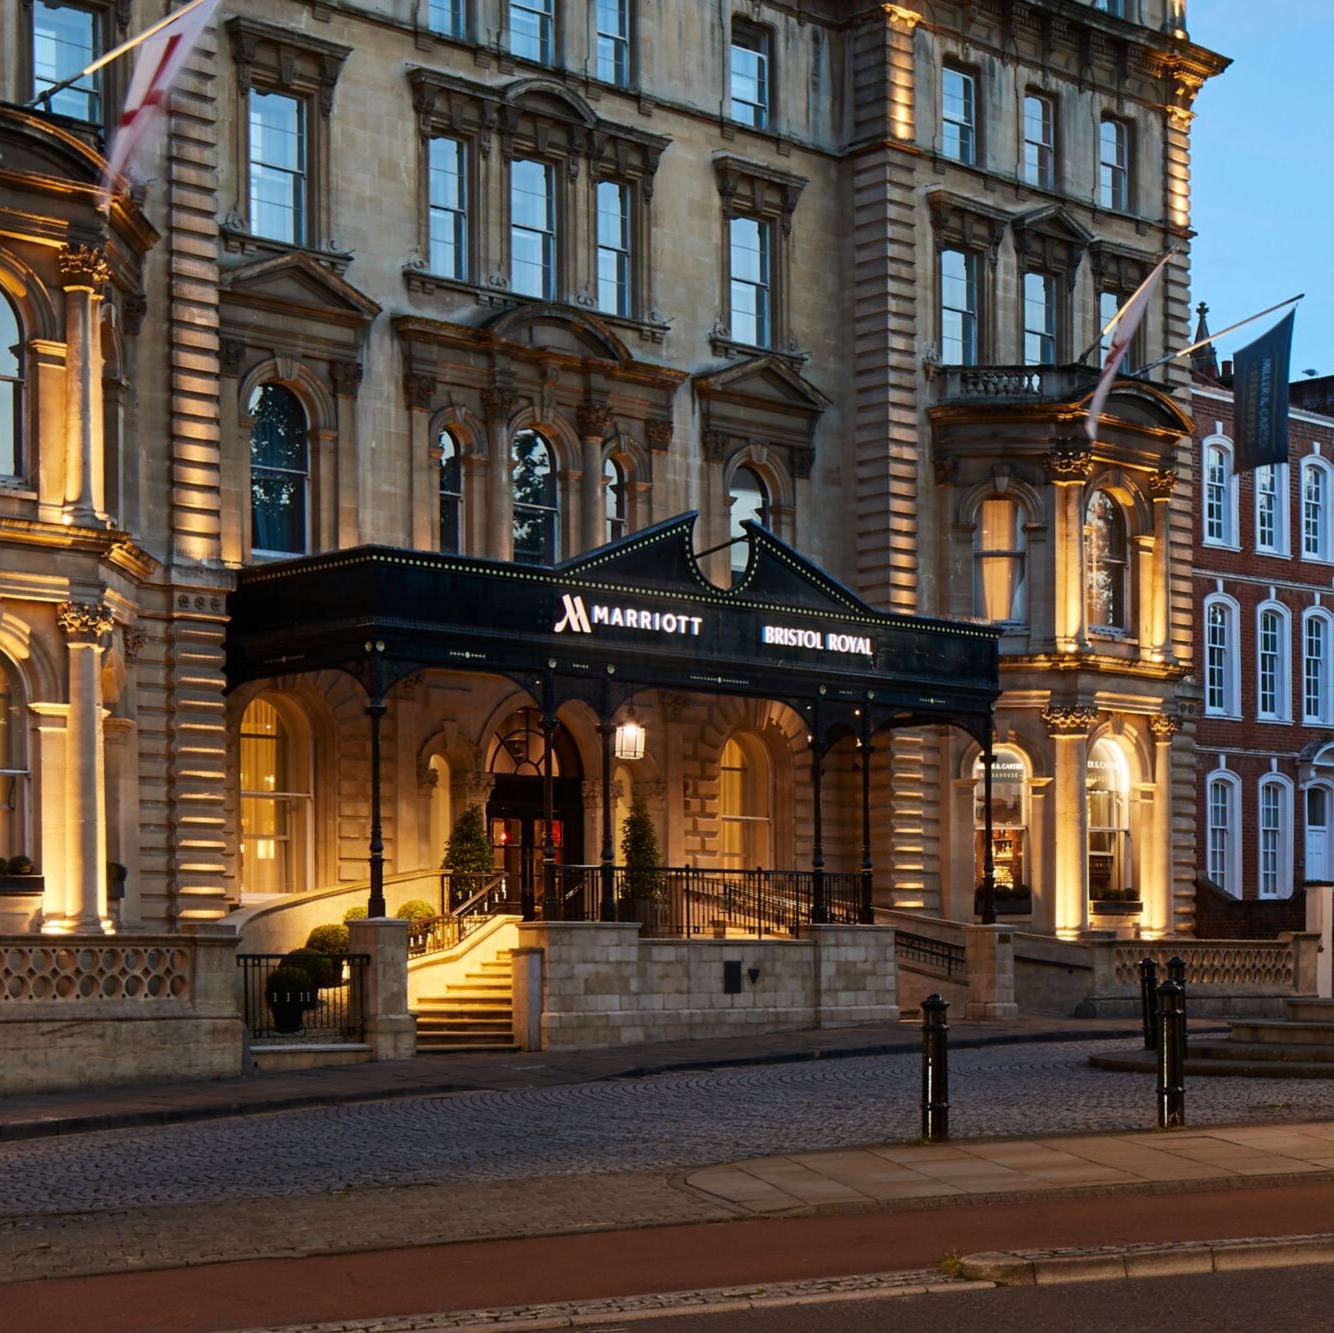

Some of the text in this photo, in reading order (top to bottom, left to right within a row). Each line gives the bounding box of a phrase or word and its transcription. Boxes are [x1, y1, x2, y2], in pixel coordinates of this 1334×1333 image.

[591, 605, 703, 636] MARRIOTT
[763, 625, 873, 655] BRISTOL ROYAL
